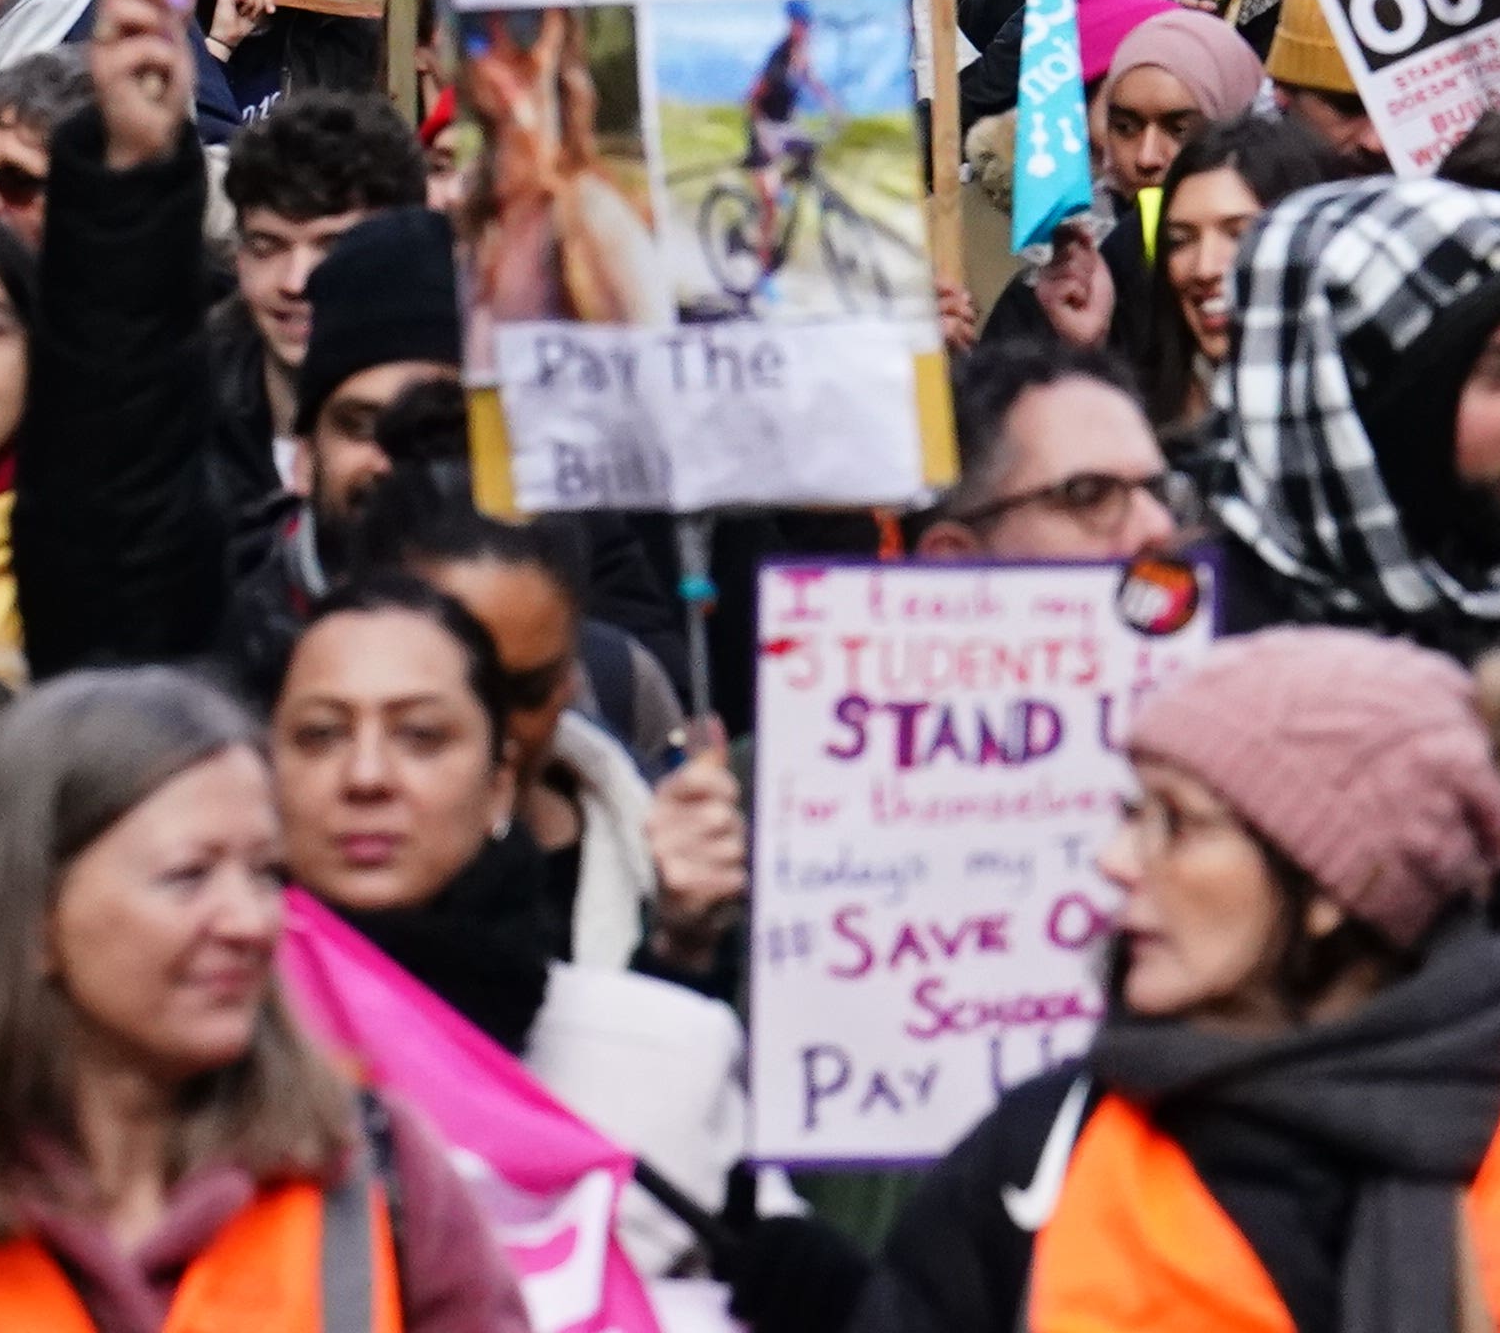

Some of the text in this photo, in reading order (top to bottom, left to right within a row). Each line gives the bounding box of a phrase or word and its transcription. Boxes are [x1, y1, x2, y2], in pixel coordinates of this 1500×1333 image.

[659, 332, 789, 393] The
[826, 695, 1064, 772] STAND
[828, 908, 1010, 980] SAVE
[802, 1043, 941, 1130] PAY
